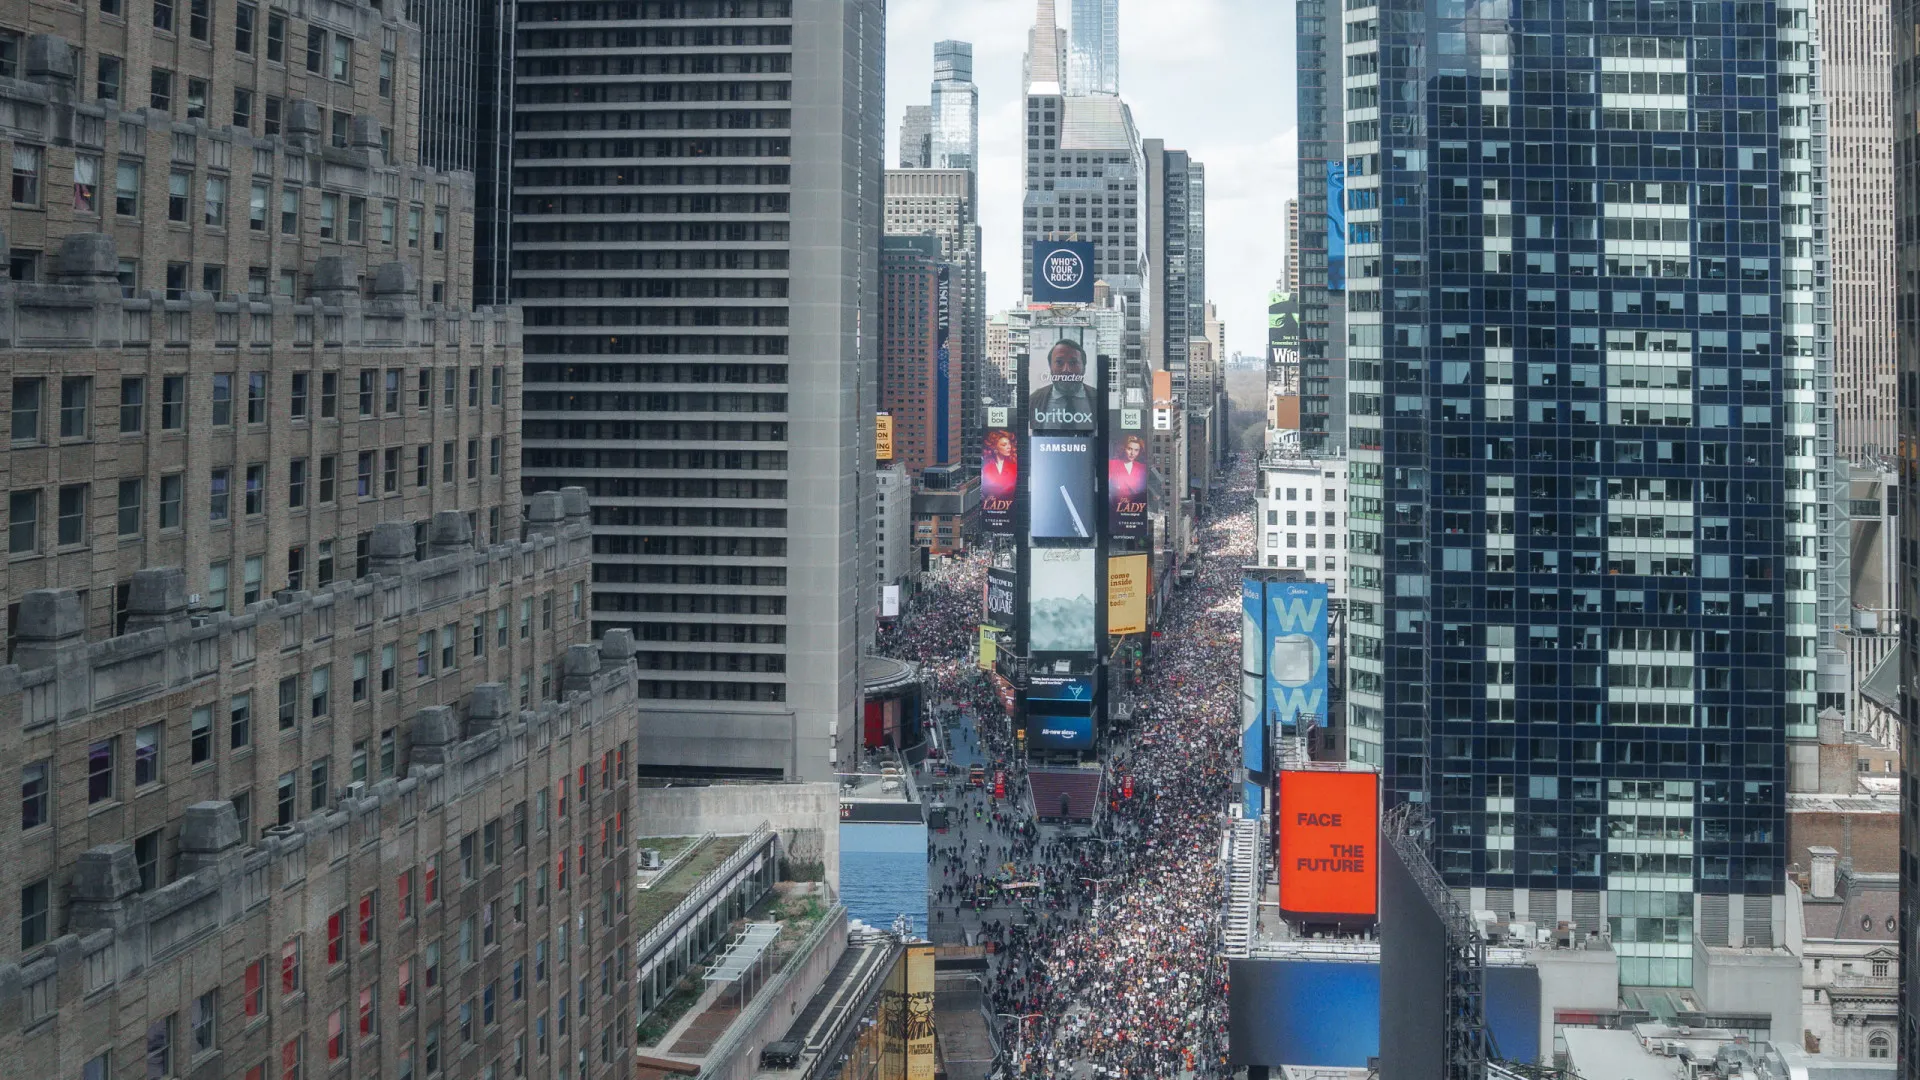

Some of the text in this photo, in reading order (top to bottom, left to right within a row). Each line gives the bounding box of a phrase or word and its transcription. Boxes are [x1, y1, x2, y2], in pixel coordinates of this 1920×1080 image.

[1051, 257, 1078, 266] WHO'S
[1051, 265, 1073, 273] YOUR
[1051, 273, 1077, 281] ROCK?
[1034, 407, 1093, 423] britbox
[1039, 443, 1087, 452] SAMSUNG
[983, 500, 1013, 510] LADY
[1116, 502, 1147, 512] LADY
[988, 596, 1014, 615] SQUARE
[1297, 812, 1342, 827] FACE
[1330, 844, 1365, 858] THE
[1297, 858, 1365, 873] FUTURE
